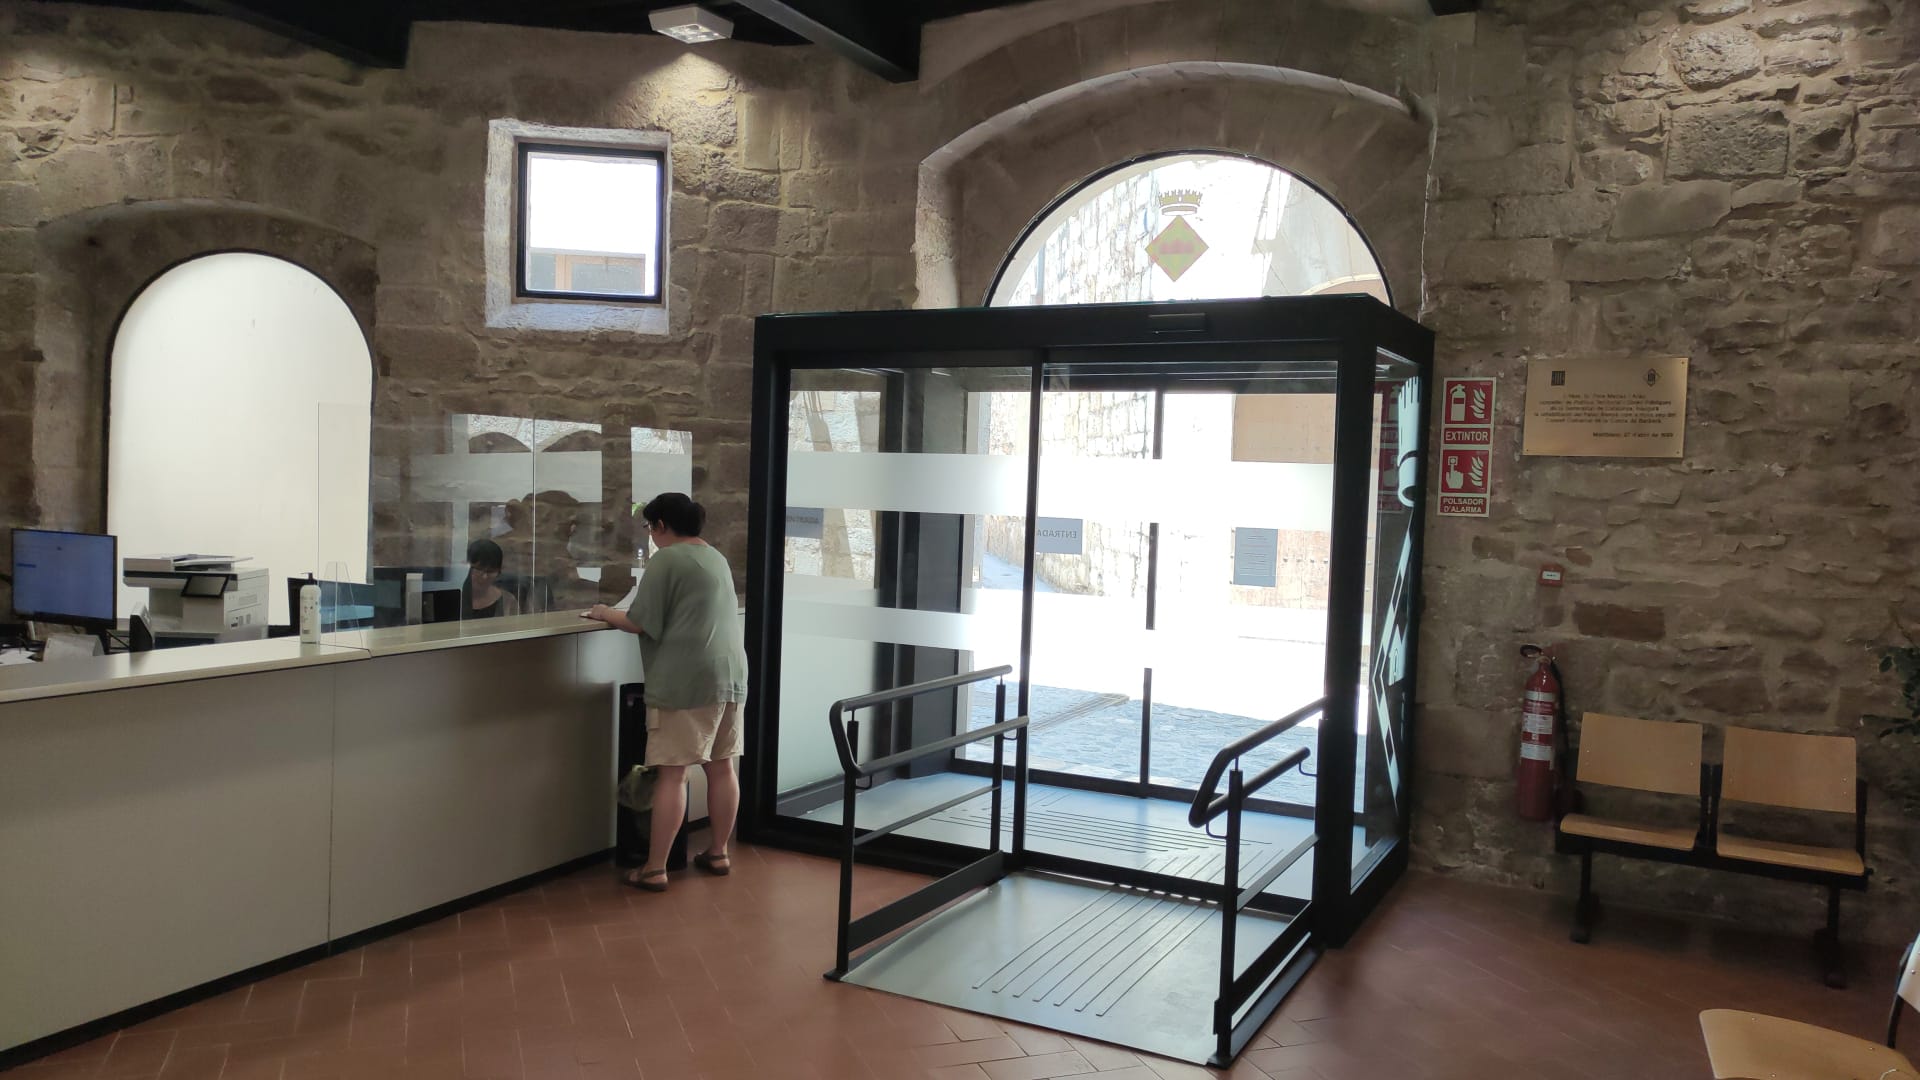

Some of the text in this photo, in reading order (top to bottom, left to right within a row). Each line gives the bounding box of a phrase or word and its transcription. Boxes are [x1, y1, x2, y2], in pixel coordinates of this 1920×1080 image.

[1445, 431, 1489, 441] EXTINTOR
[1443, 497, 1484, 505] POLSADOR
[1443, 505, 1482, 513] D'ALARMA
